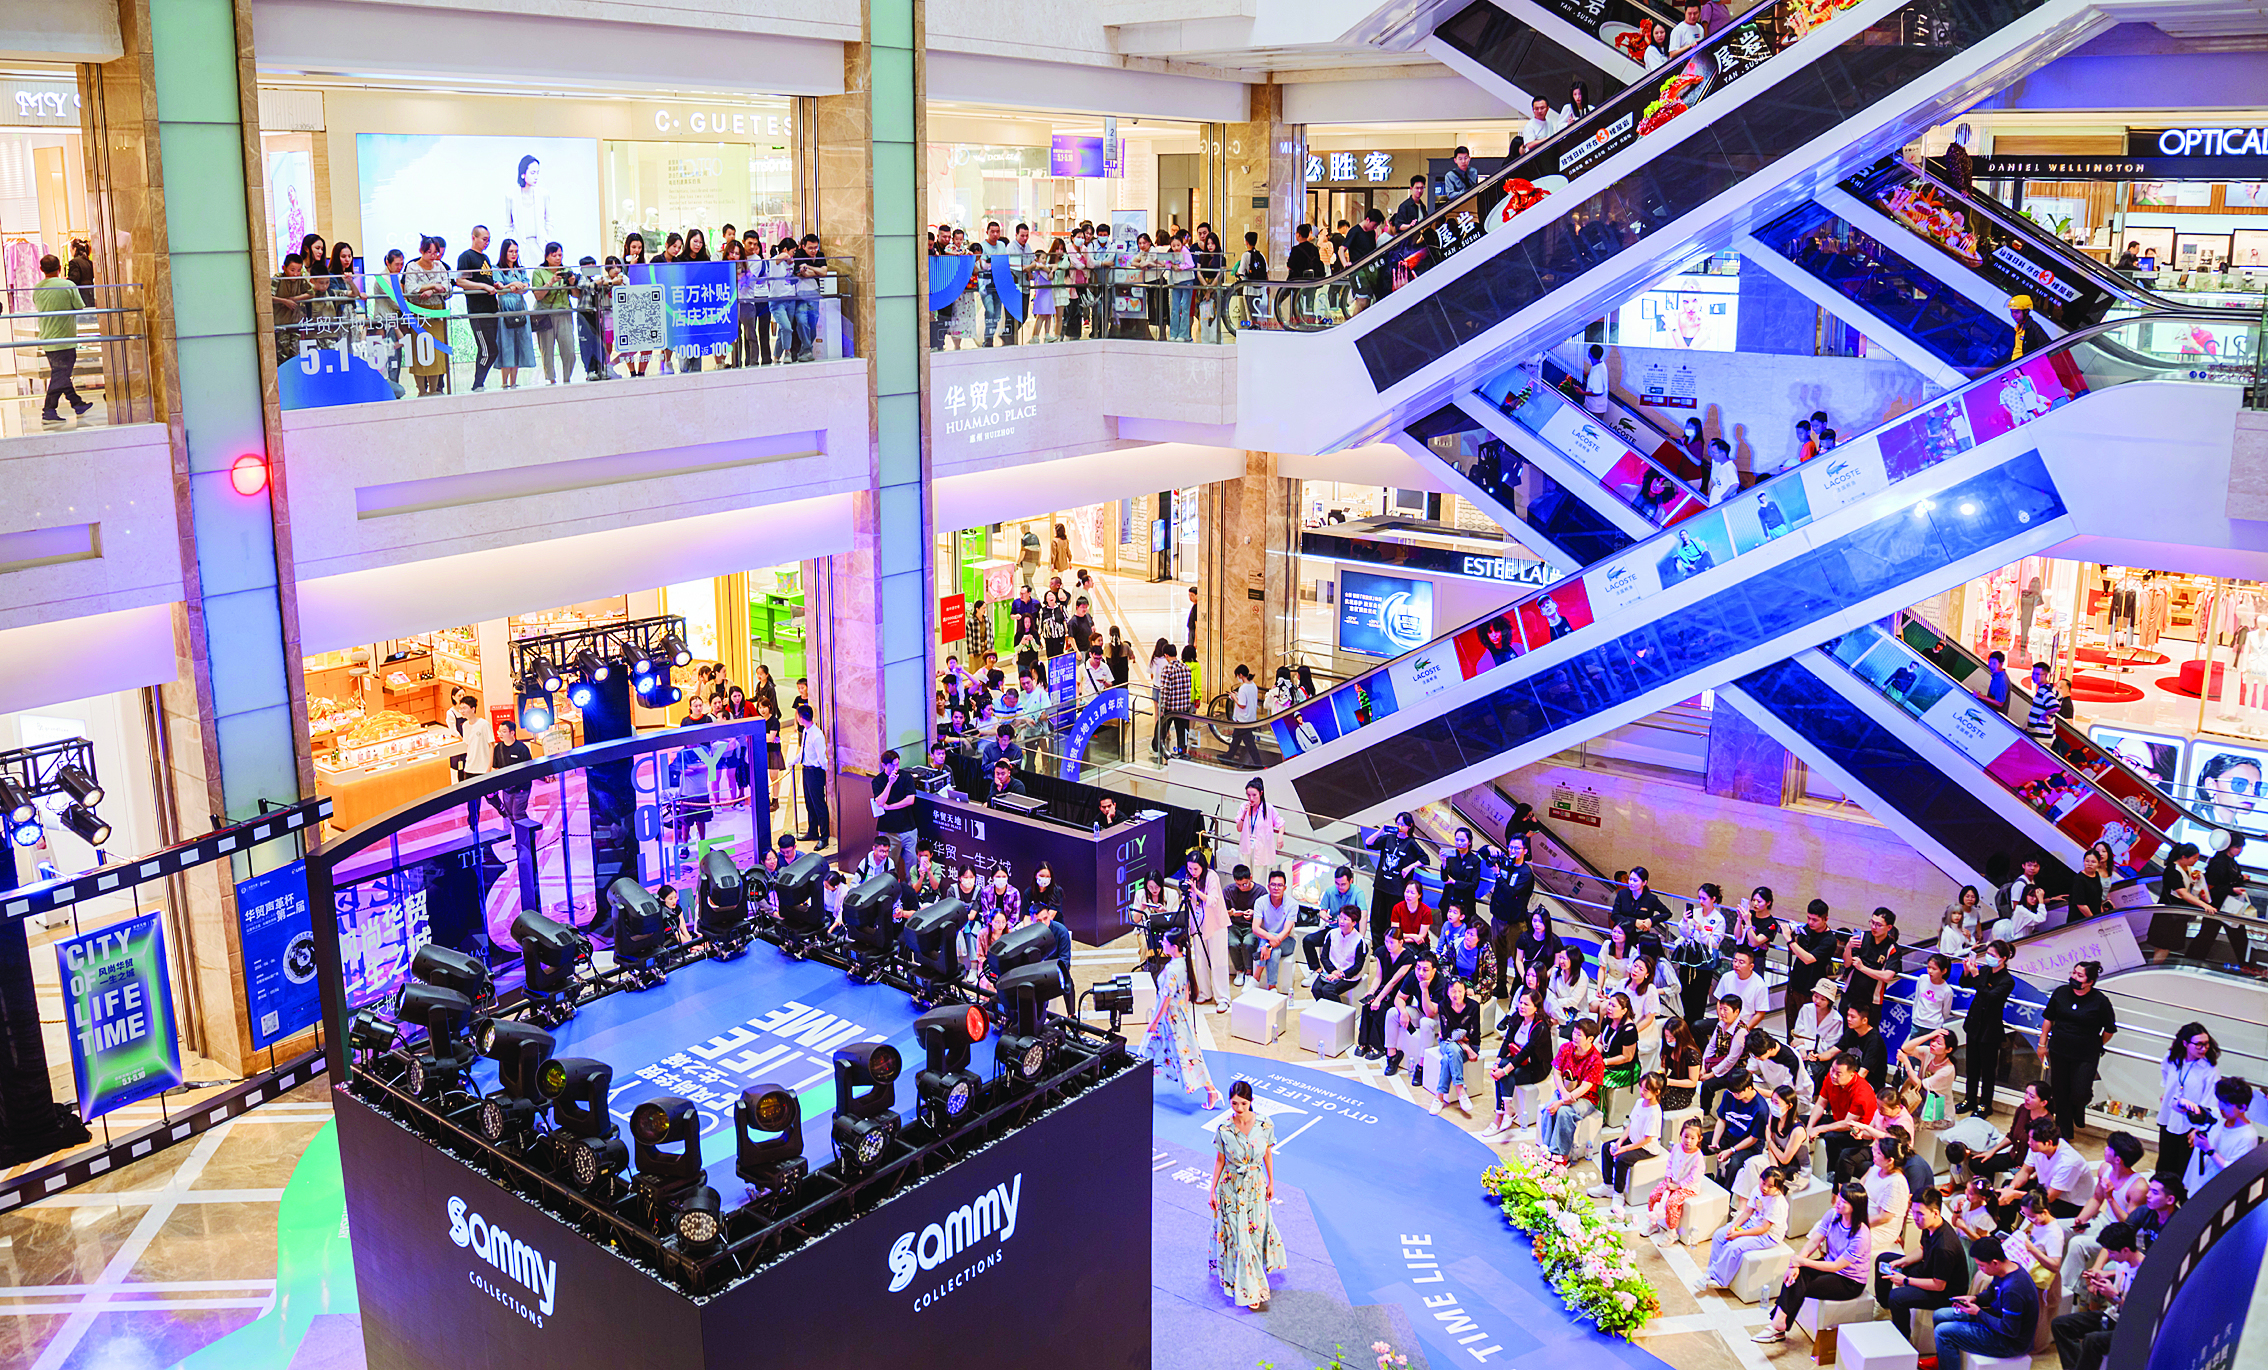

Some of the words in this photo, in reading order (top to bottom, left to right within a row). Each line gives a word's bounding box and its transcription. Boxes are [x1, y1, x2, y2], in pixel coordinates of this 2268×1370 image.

[1576, 11, 1596, 27] SUSHI
[1723, 71, 1740, 83] YAN
[1745, 53, 1769, 71] SUSHI
[1988, 163, 2040, 173] DANIEL
[2048, 163, 2145, 173] WELLINGTON
[1461, 231, 1481, 247] SUSHI
[671, 283, 731, 305] 百万补贴
[298, 311, 432, 335] 华贸天地13周年庆
[672, 307, 732, 328] 店庆狂欢
[944, 371, 1037, 417] 华贸天地
[945, 412, 1000, 435] HUAMAO
[1004, 404, 1037, 422] PLACE
[984, 426, 1015, 440] HUIZHOU
[1571, 429, 1600, 452] LACOSTE
[1608, 422, 1637, 445] LACOSTE
[1823, 467, 1862, 490] LACOSTE
[1604, 573, 1638, 593] LACOSTE
[1411, 664, 1442, 682] LACOSTE
[1066, 696, 1124, 773] 华贸天地13周年庆
[1952, 711, 1987, 739] LACOSTE
[932, 809, 962, 826] 华贸天地
[1116, 834, 1147, 862] CITY
[244, 892, 295, 922] 华贸声革杯
[276, 899, 306, 923] 第二届
[339, 888, 430, 965] 风尚华贸
[65, 927, 131, 972] CITY
[98, 957, 134, 978] 风尚华贸
[99, 967, 136, 985] 一生之城
[70, 970, 96, 997] OF
[73, 982, 142, 1029] LIFE
[77, 1011, 146, 1057] TIME
[121, 1070, 146, 1086] 5.1-5.10
[660, 1052, 739, 1089] 一生之城
[634, 1063, 721, 1104] 风尚华贸
[1267, 1072, 1338, 1099] ANNIVERSARY
[1273, 1085, 1313, 1103] LIFE
[1311, 1099, 1338, 1112] OF
[1335, 1095, 1365, 1108] 13TH
[1337, 1107, 1379, 1125] CITY
[1399, 1233, 1446, 1284] LIFE
[912, 1248, 1004, 1313] COLLECTIONS
[468, 1270, 544, 1330] COLLECTIONS
[1423, 1291, 1504, 1364] TIME
